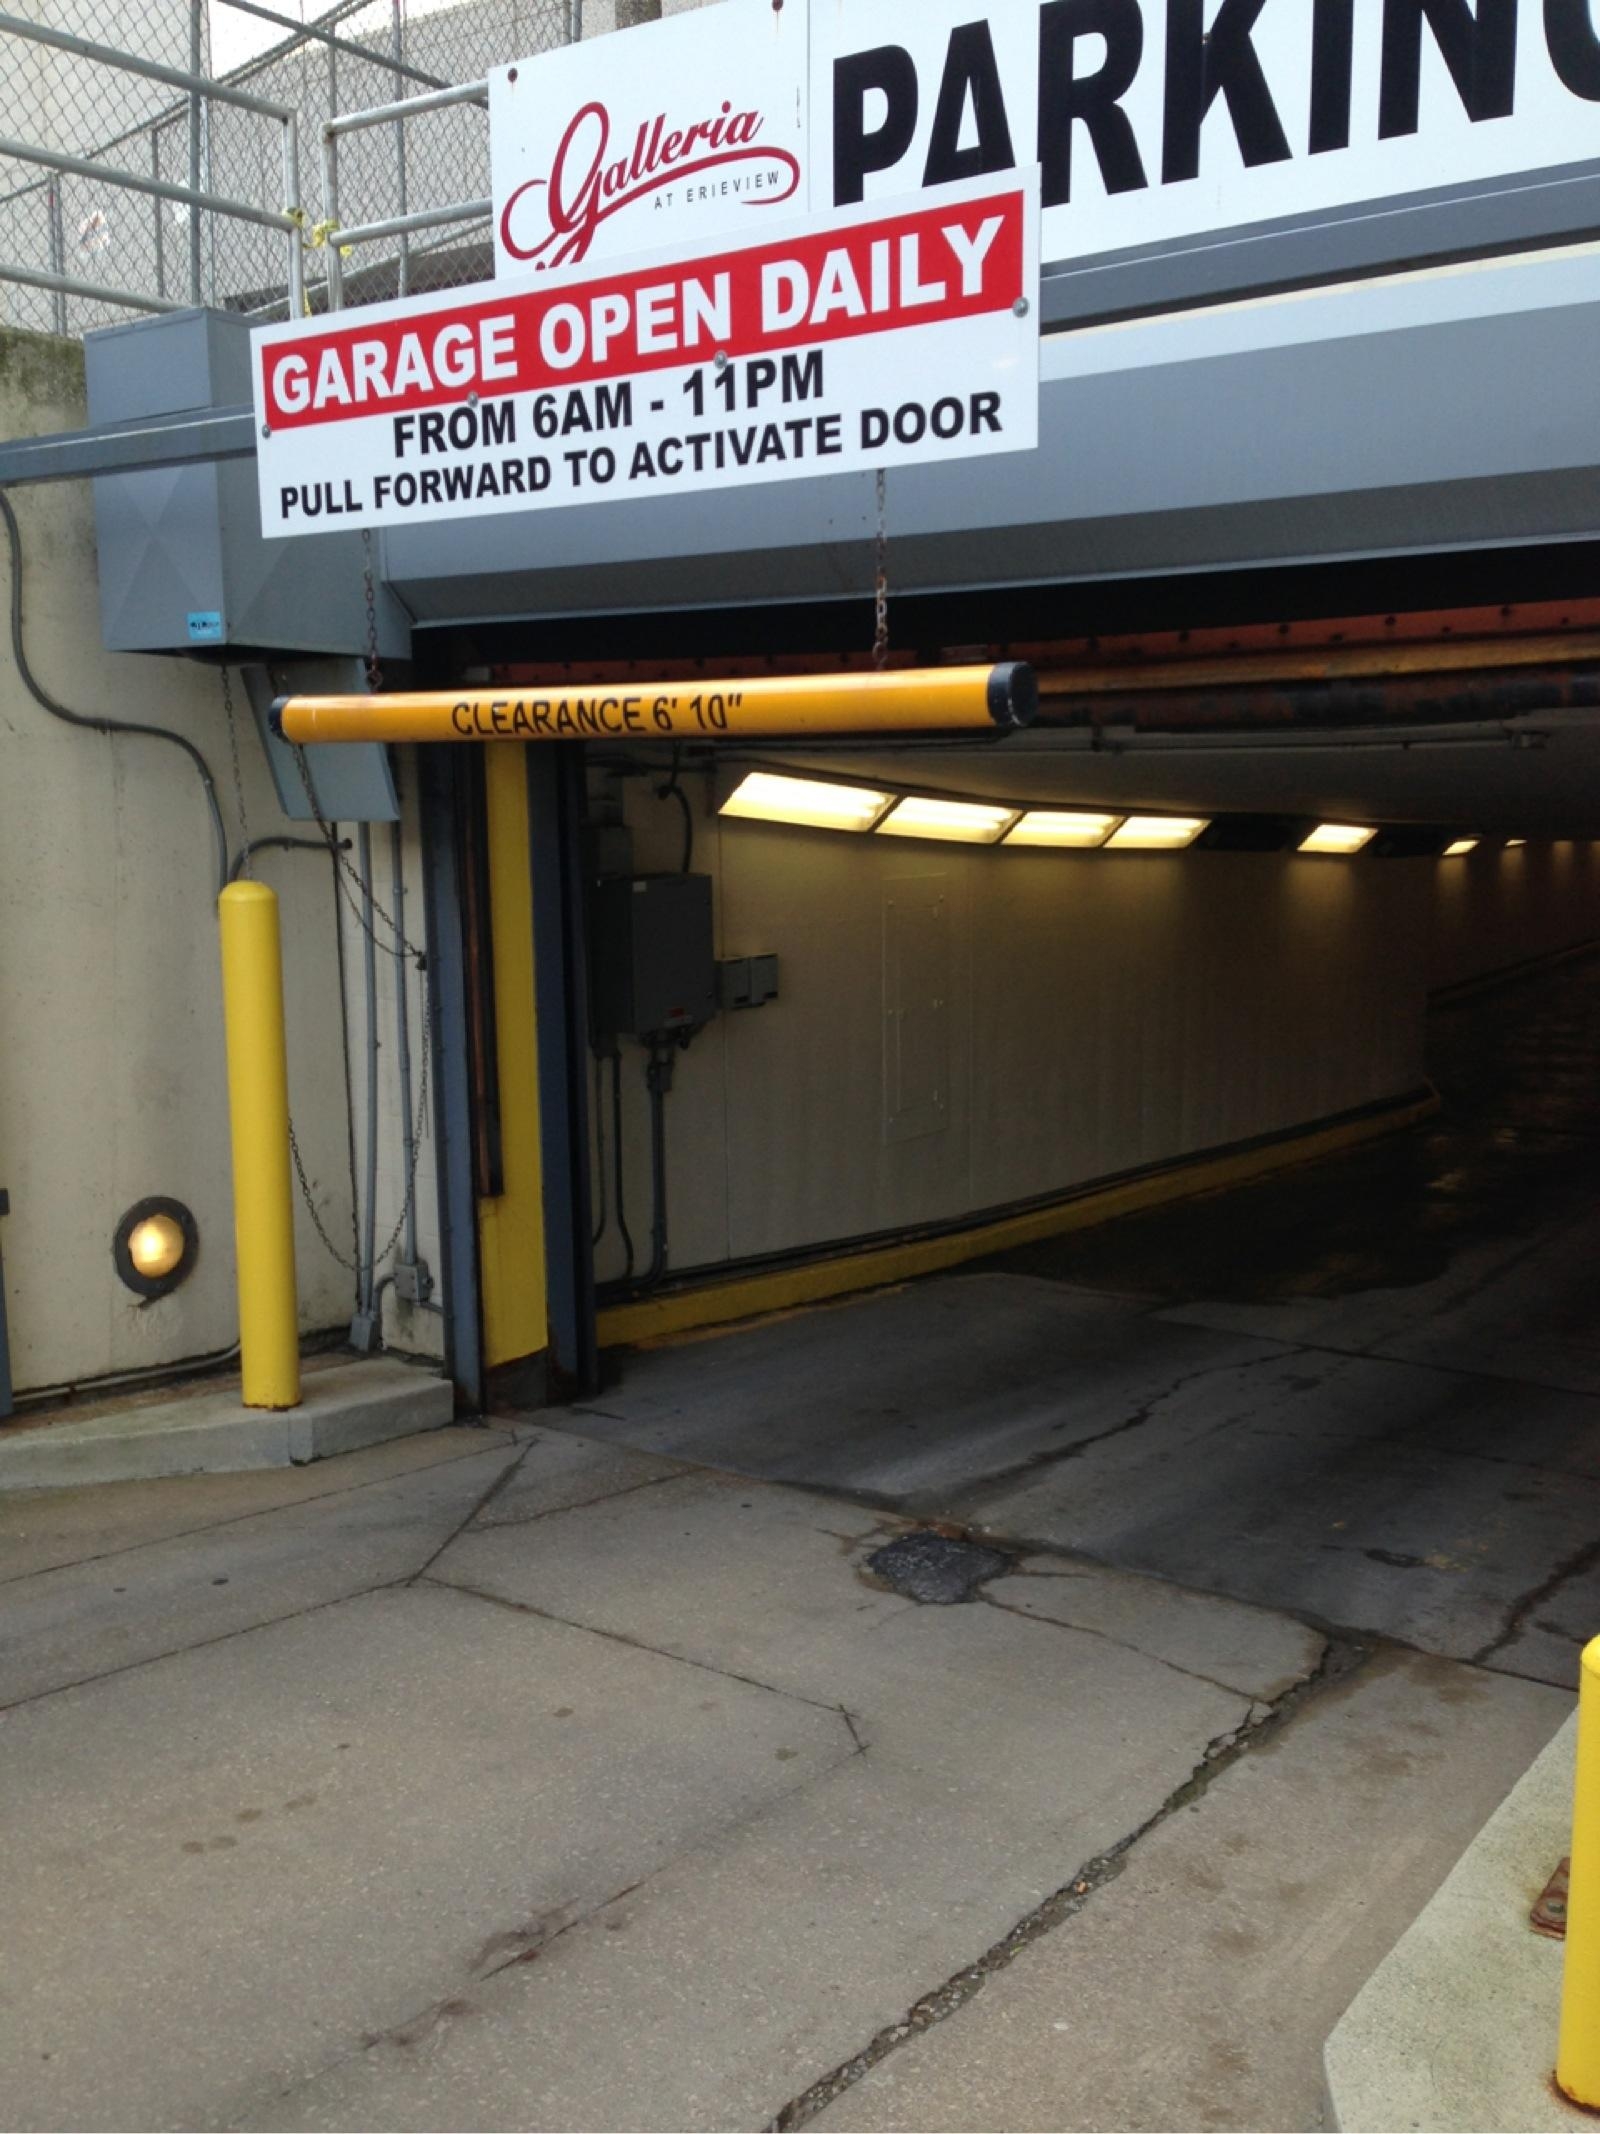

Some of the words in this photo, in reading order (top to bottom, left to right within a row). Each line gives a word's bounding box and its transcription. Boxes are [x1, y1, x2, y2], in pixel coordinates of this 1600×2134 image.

[500, 101, 764, 270] Galleria
[655, 192, 673, 209] AT
[687, 171, 779, 202] ERIEVIEW
[273, 314, 517, 414] GARAGE
[539, 271, 731, 370] OPEN
[761, 215, 1005, 333] DAILY
[281, 480, 363, 518] PULL
[373, 455, 551, 511] FORWARD
[564, 446, 616, 487] TO
[629, 413, 842, 480] ACTIVATE
[860, 391, 1003, 450] DOOR
[393, 400, 516, 458] FROM
[532, 381, 632, 439] 6AM
[650, 399, 665, 411] -
[683, 349, 823, 417] 11PM
[452, 697, 646, 735] CLEARANCE
[652, 696, 678, 731] 6'
[690, 692, 742, 730] 10"
